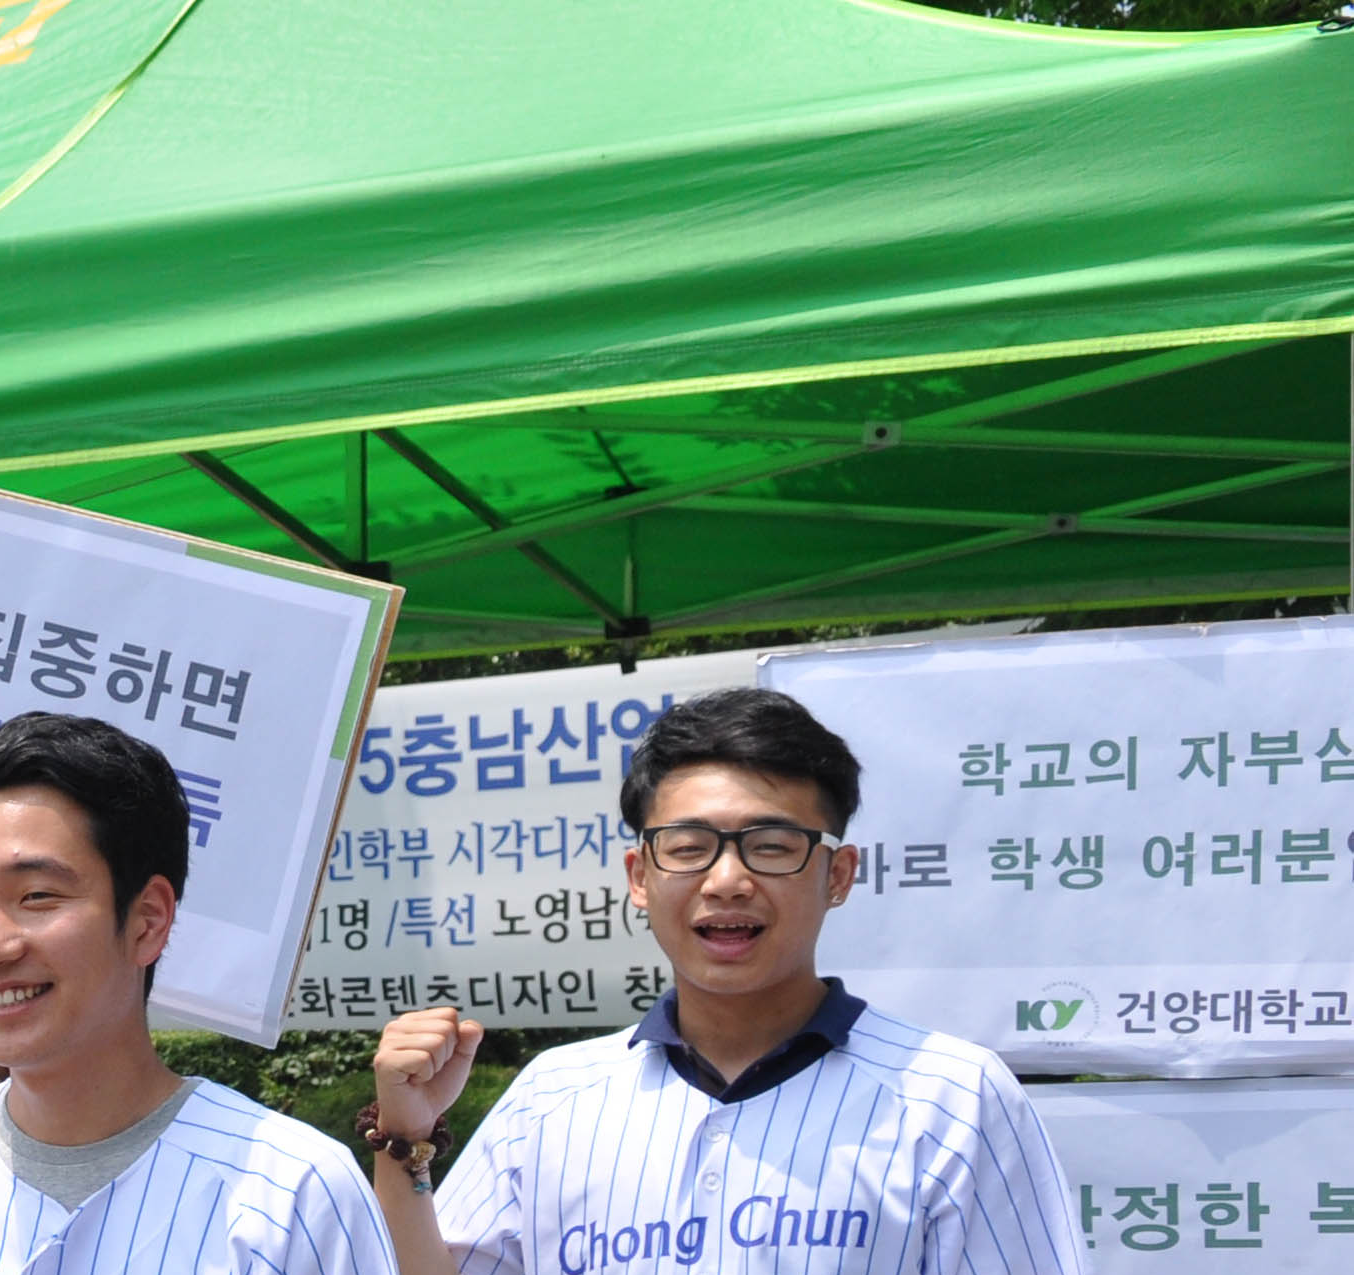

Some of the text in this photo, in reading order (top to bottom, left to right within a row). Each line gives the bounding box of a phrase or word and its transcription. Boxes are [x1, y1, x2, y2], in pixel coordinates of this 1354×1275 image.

[958, 735, 1139, 796] 학교의
[988, 834, 1106, 891] 학생
[1143, 827, 1354, 887] 여러분
[289, 968, 597, 1017] 화콘텐츠디자인
[1116, 988, 1354, 1036] 건양대학교
[729, 1194, 870, 1249] Chun
